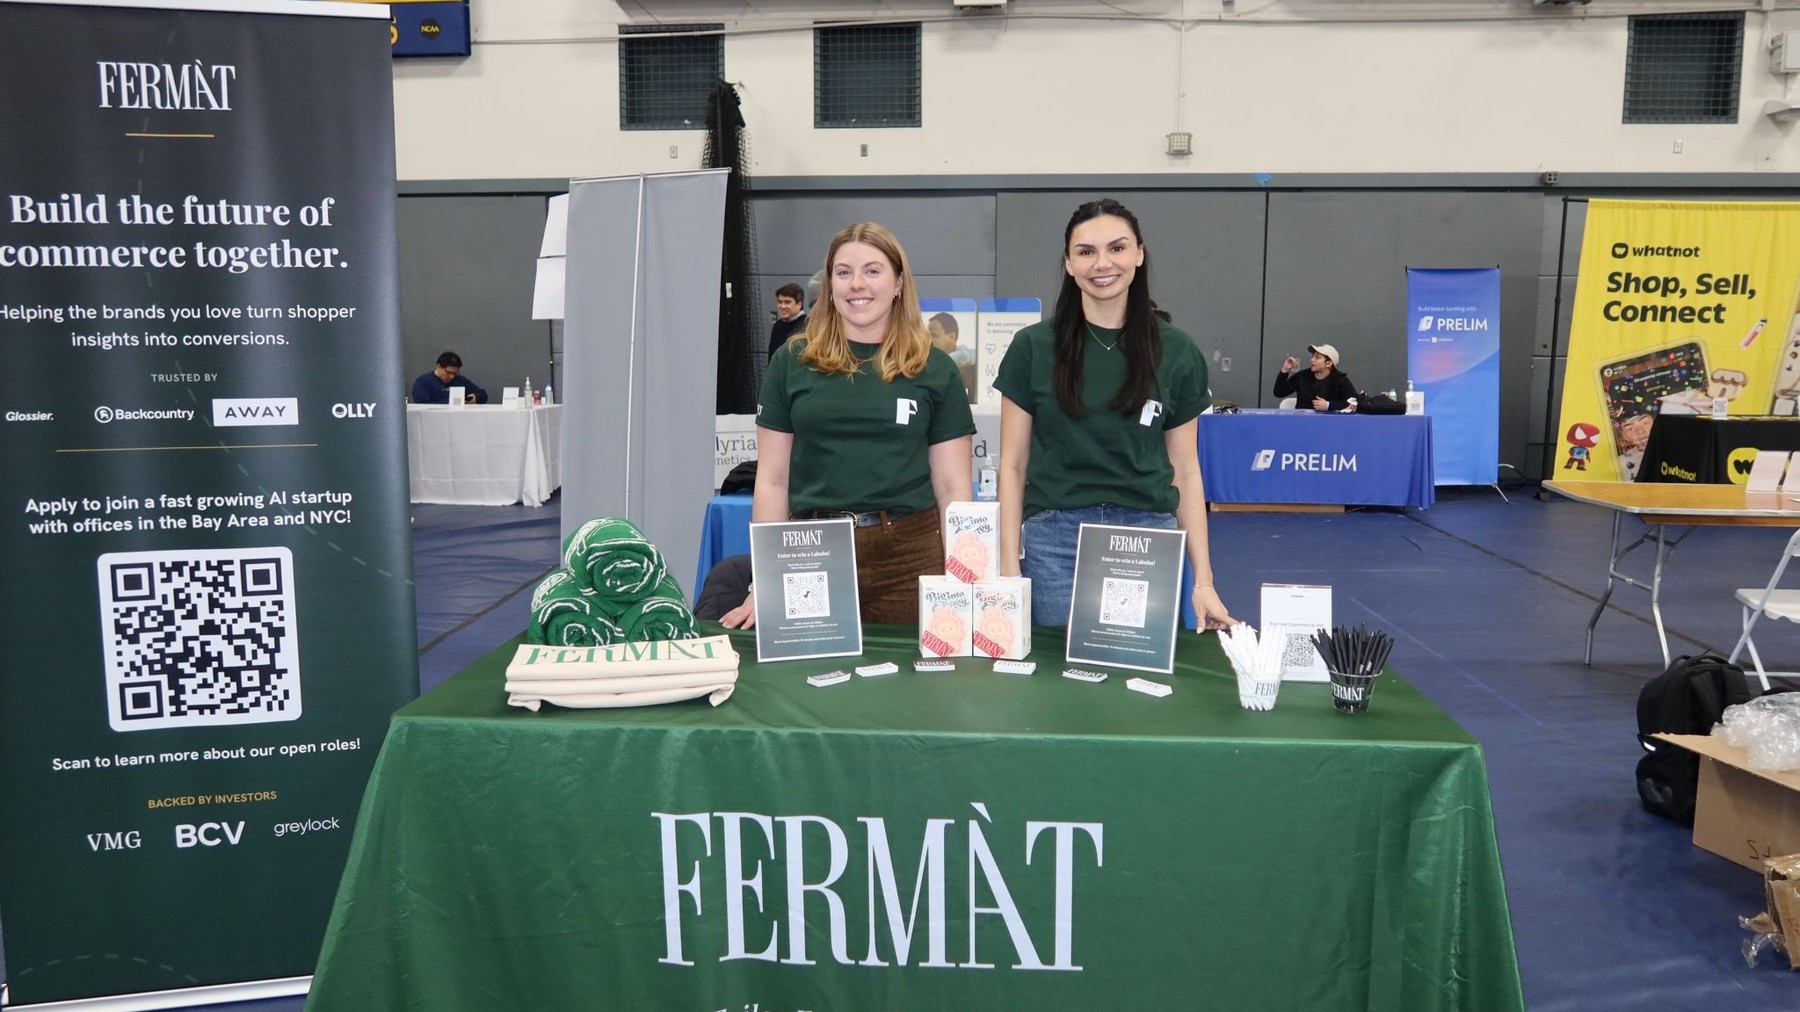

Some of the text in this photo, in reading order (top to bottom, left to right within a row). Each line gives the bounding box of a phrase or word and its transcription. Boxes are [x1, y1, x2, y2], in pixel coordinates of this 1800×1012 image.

[421, 25, 440, 33] NCAA
[97, 59, 236, 111] FERMÀT
[10, 194, 335, 227] Build the future of
[0, 239, 349, 273] commerce together.
[1632, 245, 1700, 258] whatnot
[1607, 272, 1757, 299] Shop, Sell,
[68, 305, 97, 320] the
[103, 304, 165, 320] brands
[171, 307, 201, 324] you
[205, 304, 241, 319] love
[246, 305, 282, 319] turn
[287, 305, 356, 323] shopper
[1603, 300, 1726, 324] Connect
[1437, 318, 1488, 331] PRELIM
[71, 331, 289, 350] insights into conversions.
[151, 373, 218, 383] TRUSTED BY
[5, 411, 54, 422] Glossier.
[115, 408, 195, 422] Backcountry
[225, 405, 287, 419] AWAY
[331, 403, 376, 418] OLLY
[1281, 453, 1357, 472] PRELIM
[25, 490, 352, 516] Apply to join a fast growing AI startup
[29, 509, 352, 534] with offices in the Bay Area and NYC!
[52, 738, 361, 771] Scan to learn more about our open roles!
[148, 790, 277, 809] BACKED BY INVESTORS
[175, 821, 246, 848] BCV
[274, 816, 340, 837] greylock
[87, 831, 142, 852] VMG
[650, 801, 1103, 972] FERMÀT
